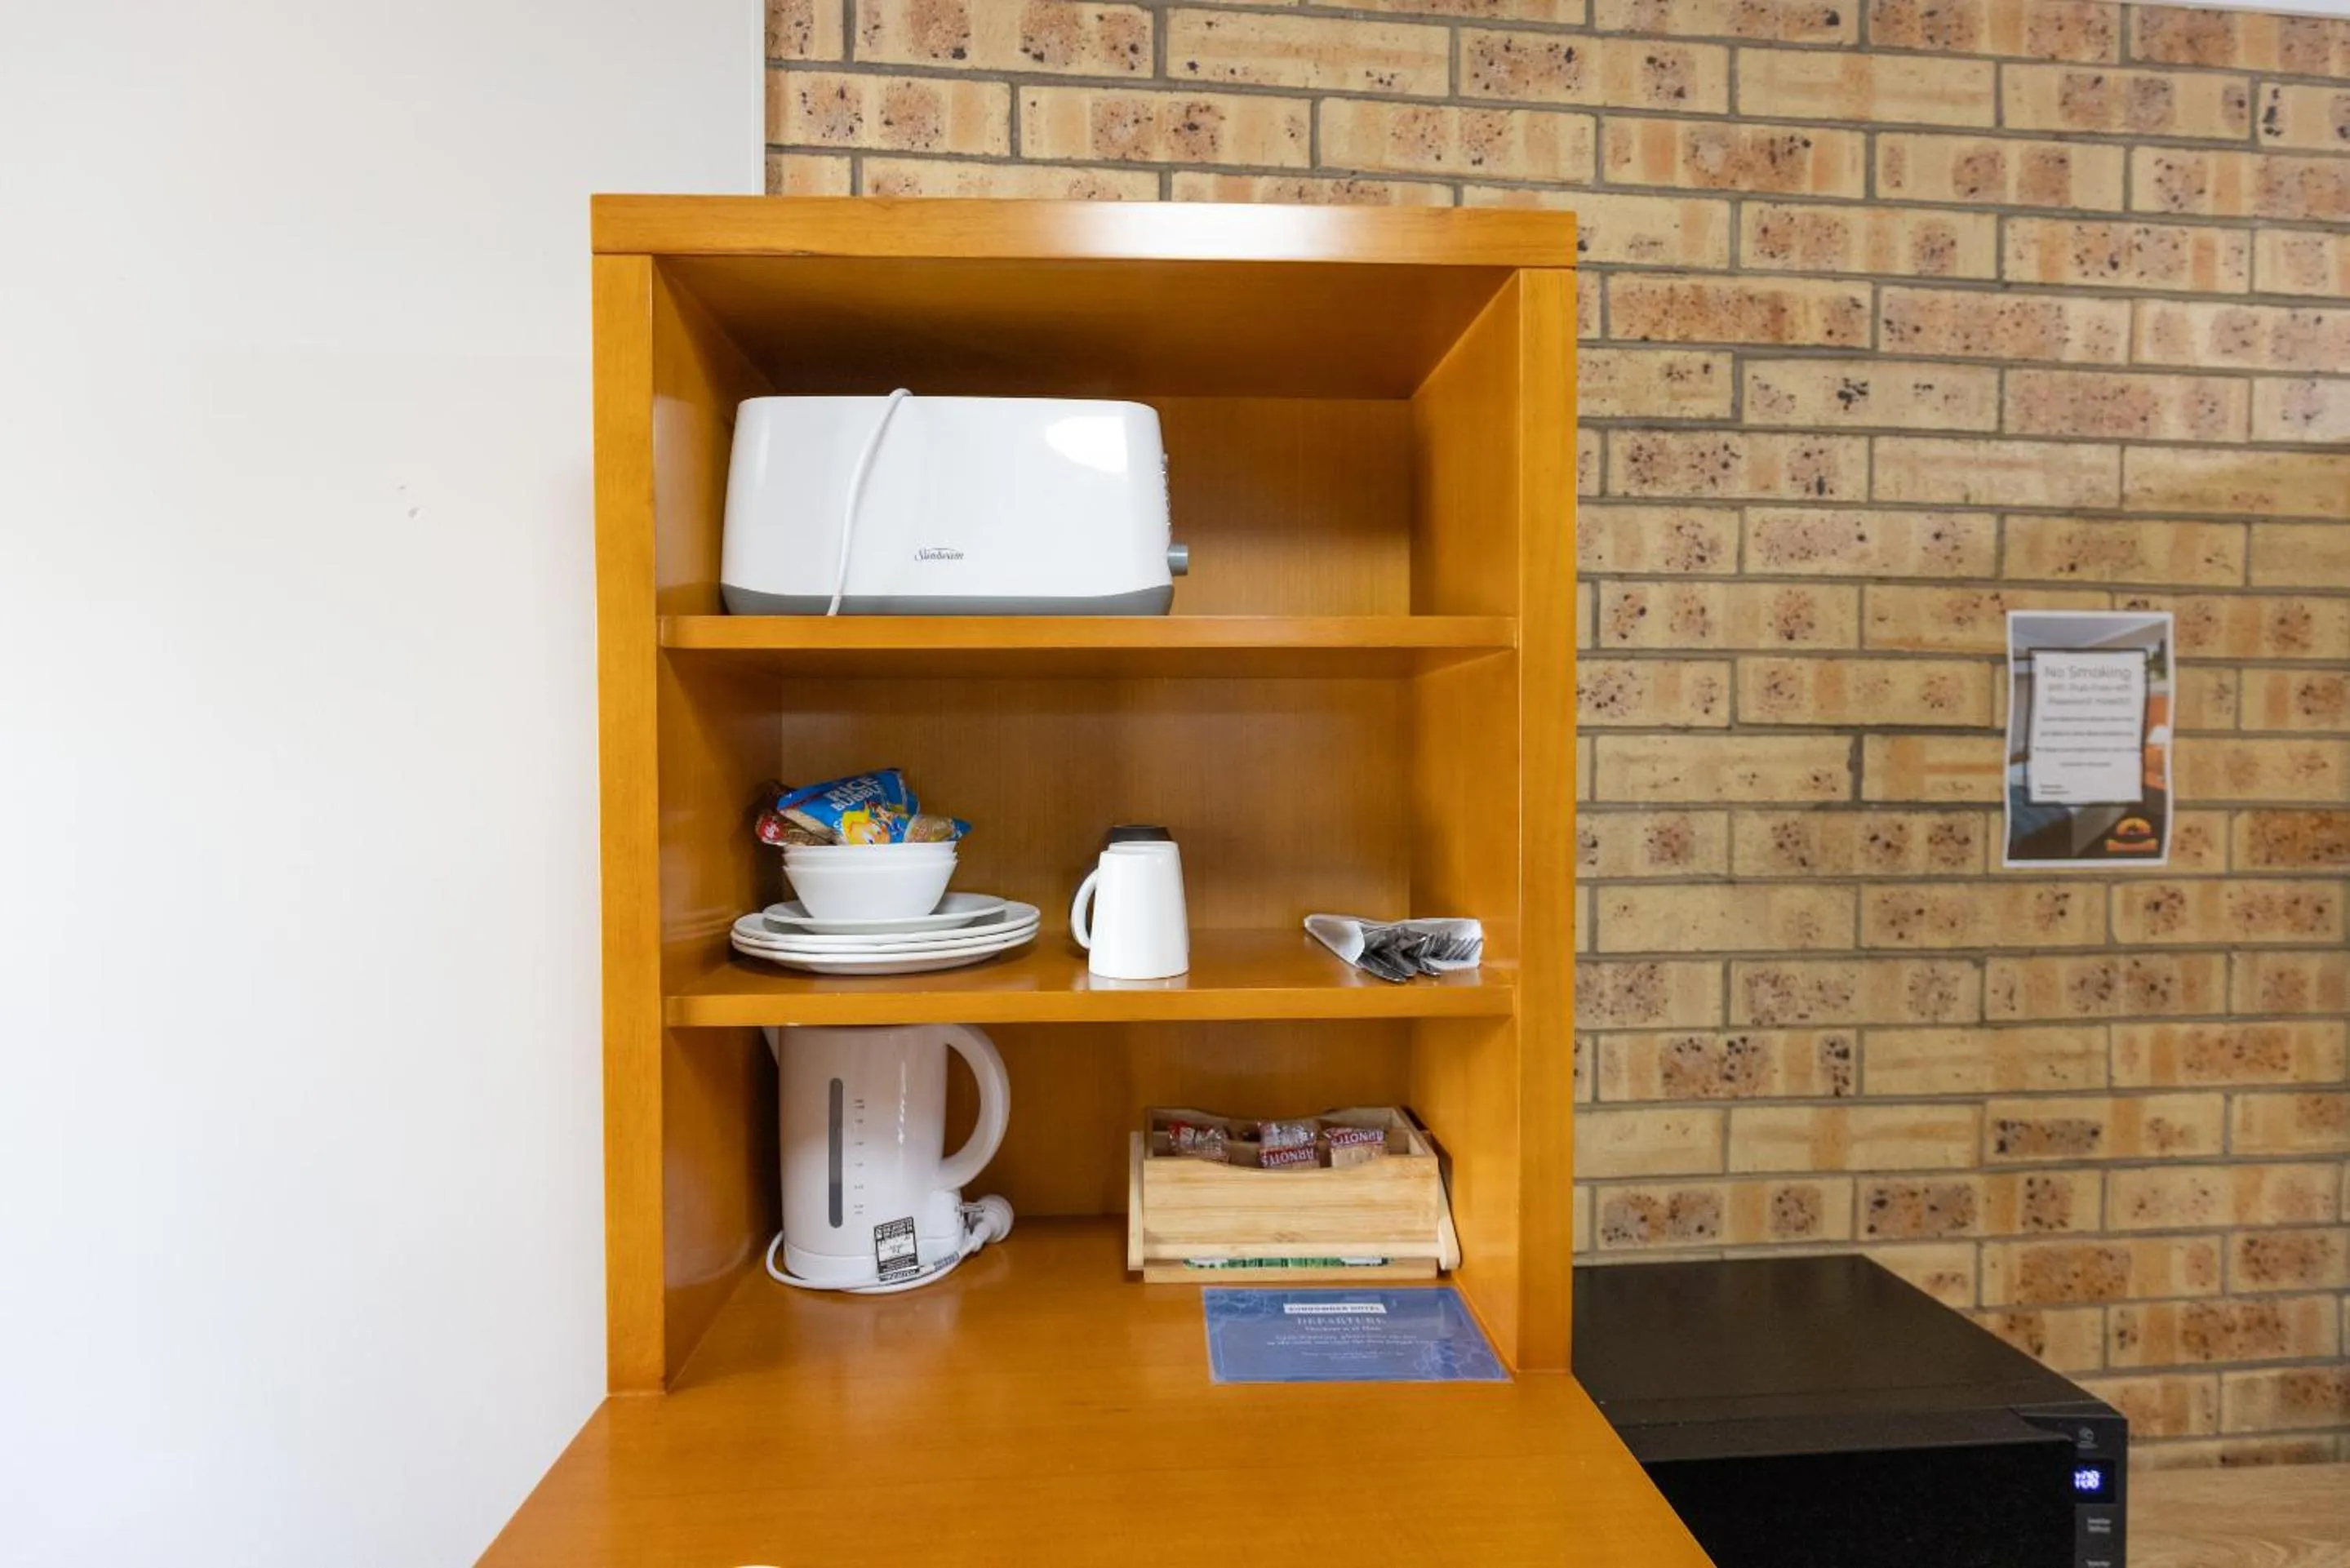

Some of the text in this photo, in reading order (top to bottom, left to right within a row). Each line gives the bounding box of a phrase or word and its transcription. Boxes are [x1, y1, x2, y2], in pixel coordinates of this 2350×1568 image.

[2045, 664, 2132, 681] No Smoking
[824, 776, 879, 801] RICE
